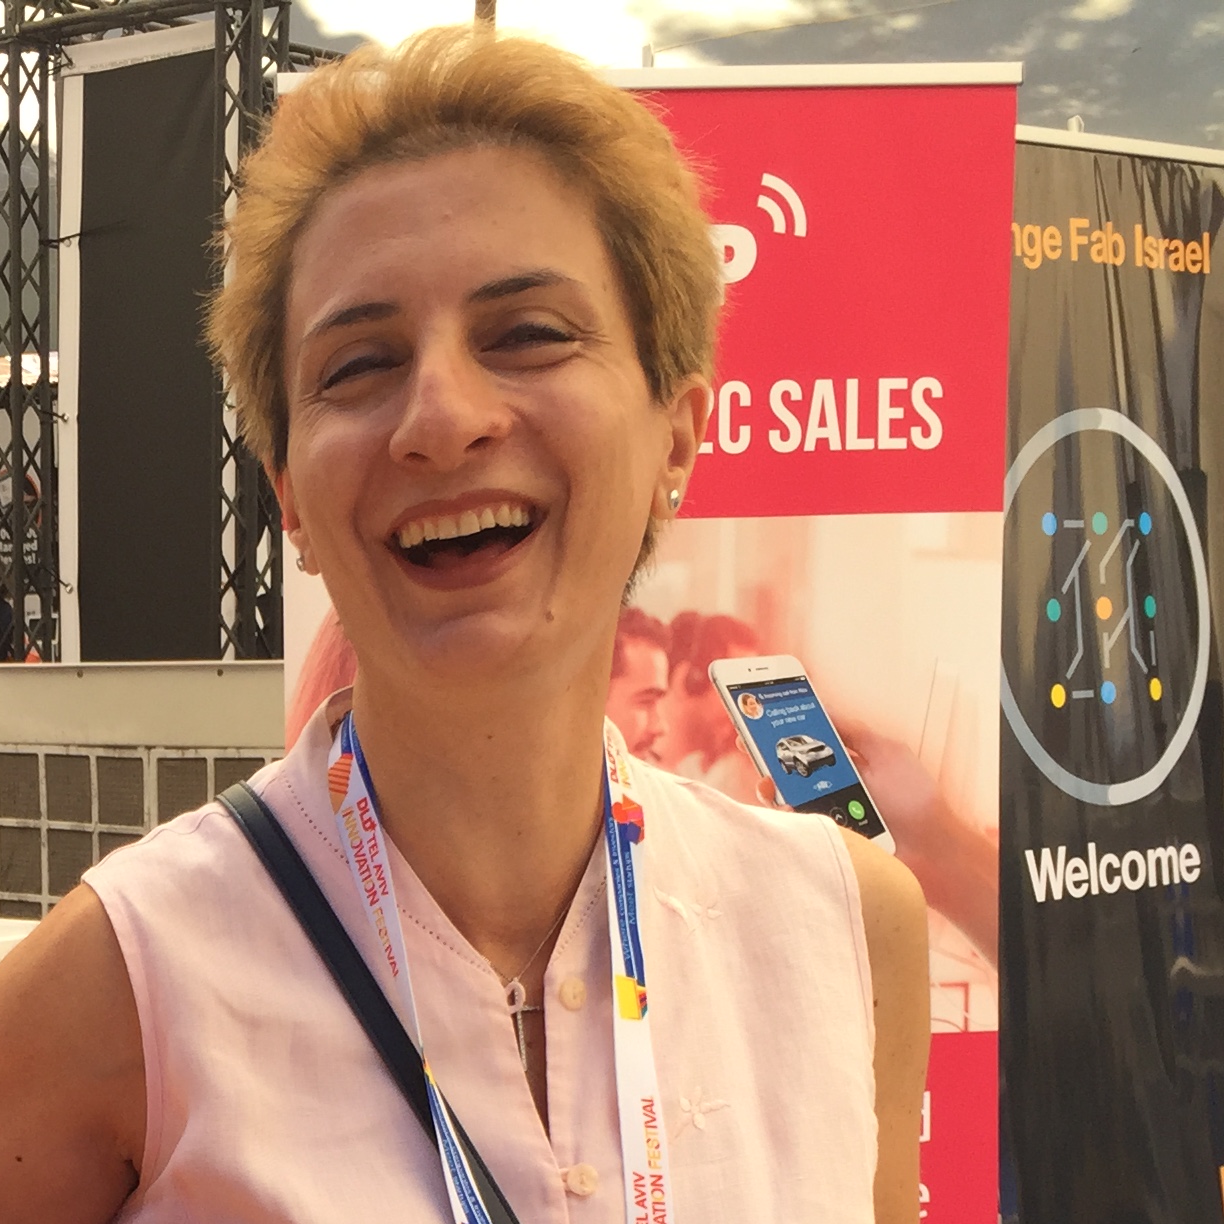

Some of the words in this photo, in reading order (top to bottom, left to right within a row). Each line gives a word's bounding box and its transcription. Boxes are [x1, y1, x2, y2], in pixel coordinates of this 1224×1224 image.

[1069, 217, 1126, 266] Fab
[1134, 223, 1211, 274] Israel
[768, 376, 944, 453] SALES
[341, 806, 380, 908] INNOVATION
[366, 836, 380, 865] TEL
[373, 864, 389, 897] AVIV
[1025, 842, 1201, 903] Welcome
[641, 1095, 663, 1170] FESTIVAL
[633, 1171, 648, 1210] AVIV
